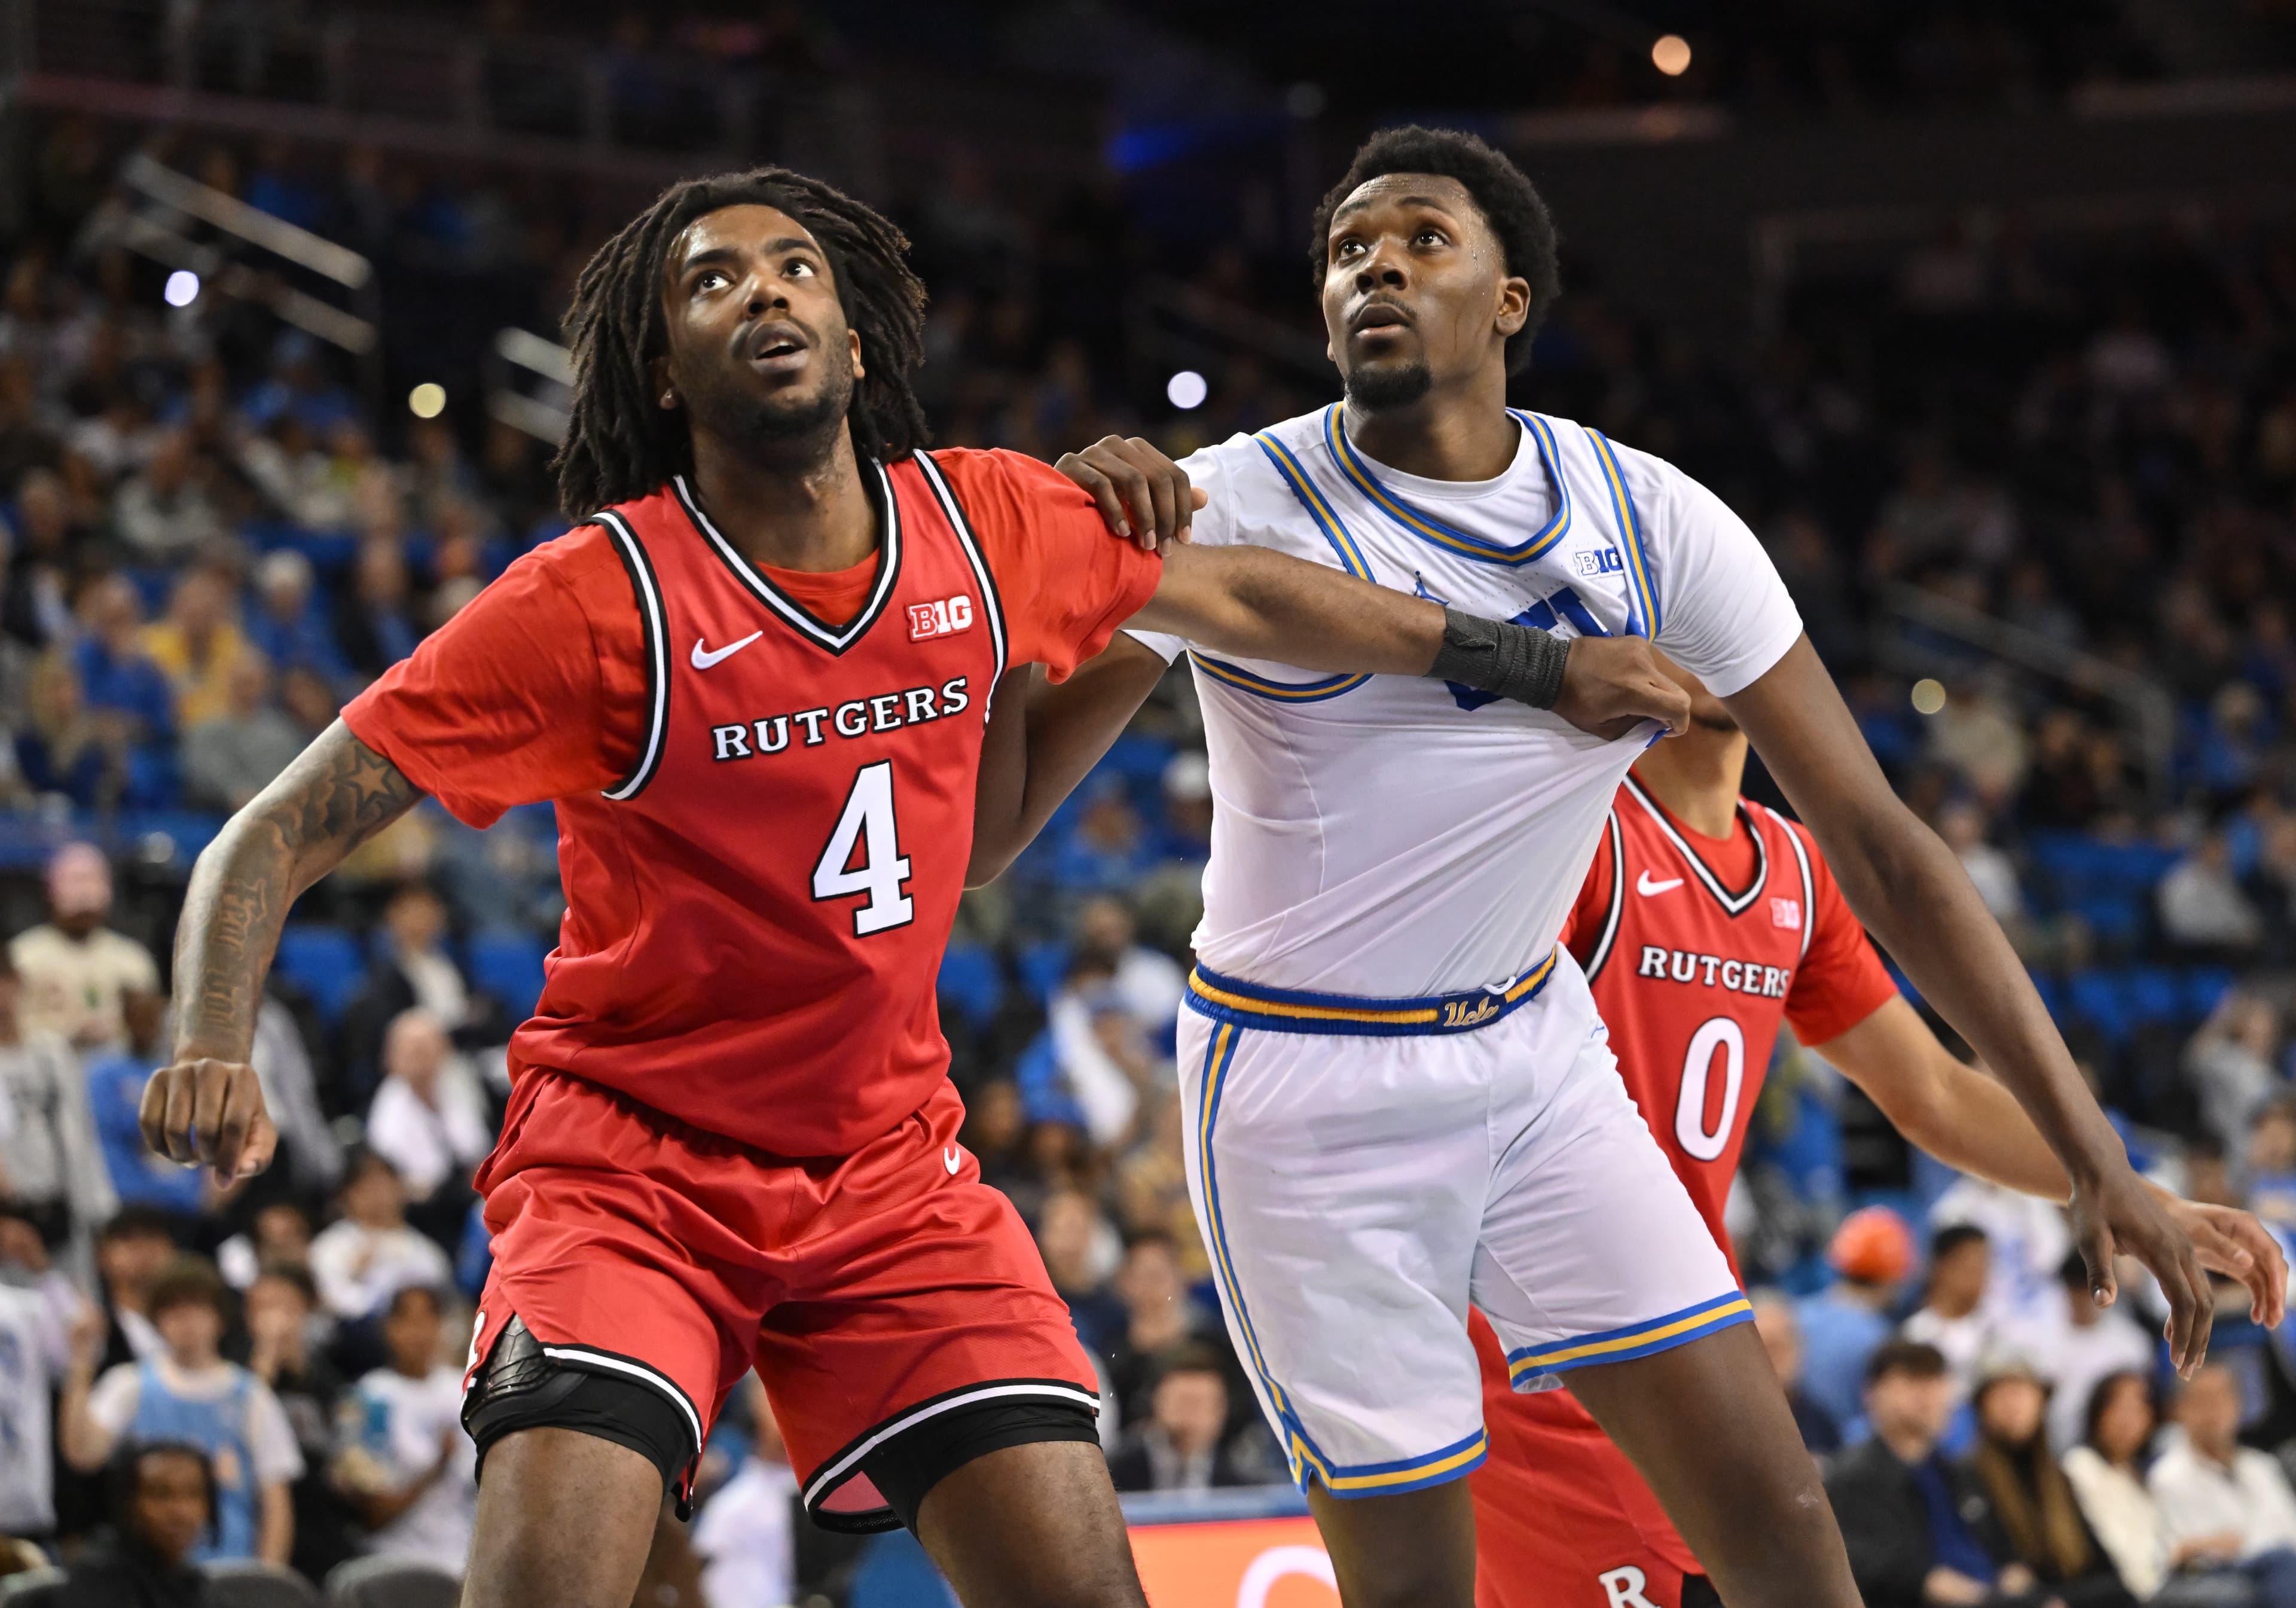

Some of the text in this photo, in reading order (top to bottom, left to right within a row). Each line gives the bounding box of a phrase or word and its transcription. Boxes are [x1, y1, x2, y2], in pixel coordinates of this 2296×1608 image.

[712, 676, 970, 761] RUTGERS
[810, 758, 914, 938] 4
[1638, 945, 1791, 998] RUTGERS
[1675, 1016, 1745, 1162] 0
[1598, 1565, 1663, 1608] R
